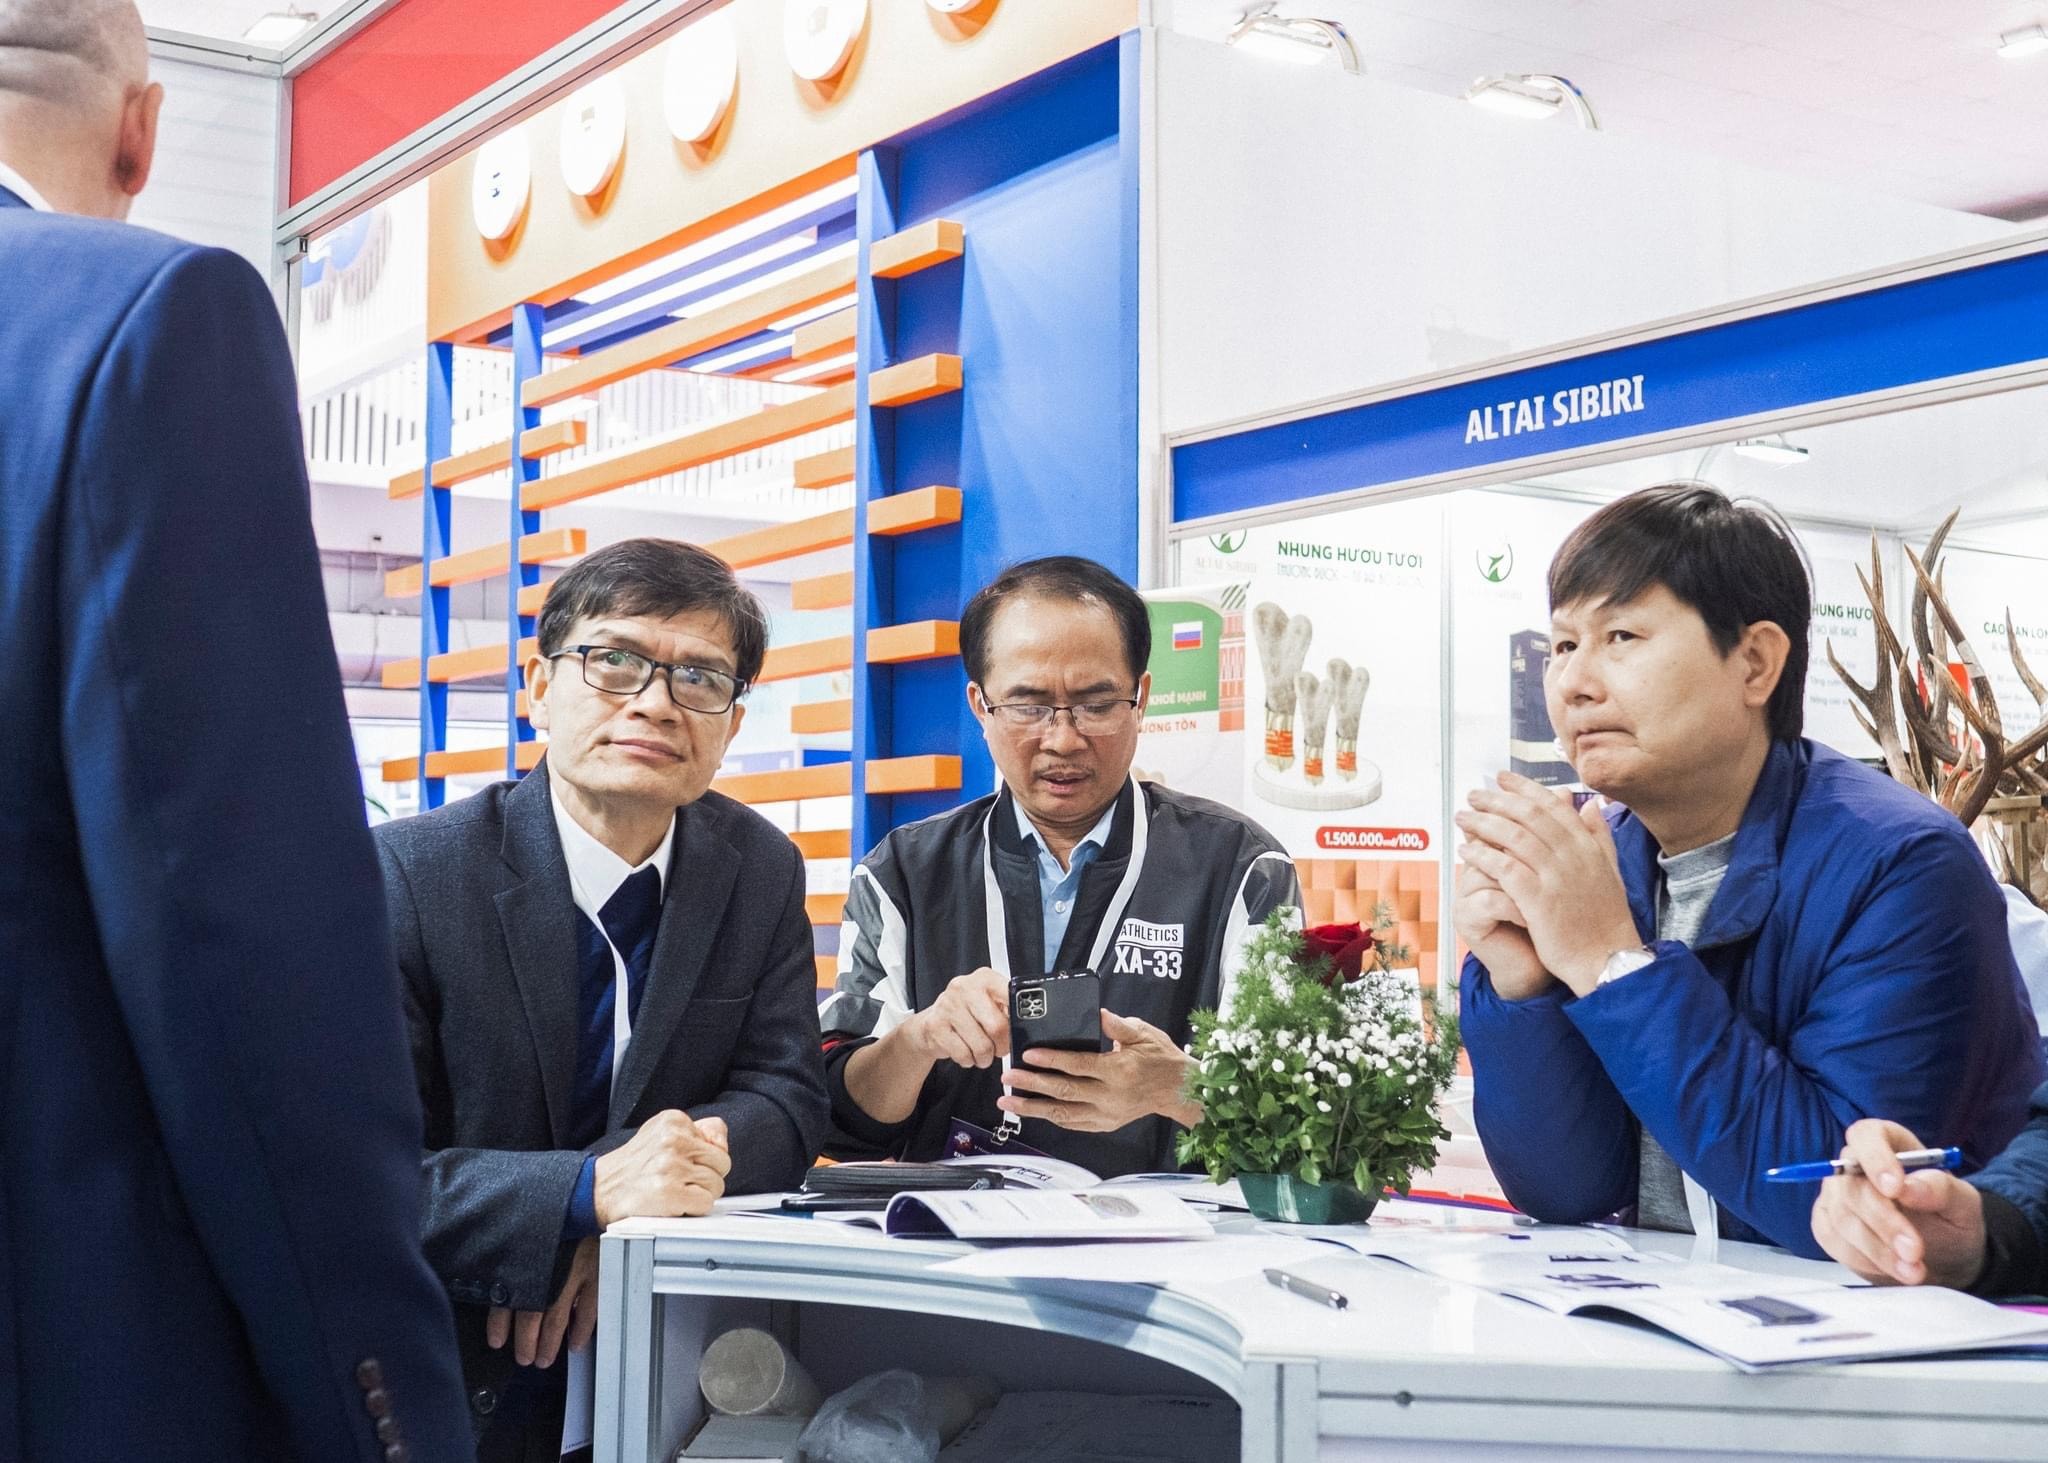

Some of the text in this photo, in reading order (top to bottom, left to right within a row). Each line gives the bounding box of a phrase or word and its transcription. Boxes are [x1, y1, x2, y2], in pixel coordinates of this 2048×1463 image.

[1465, 374, 1645, 444] ALTAI SIBIRI
[1277, 540, 1333, 560] NHUNG
[1810, 602, 1844, 618] HUNG
[1983, 621, 2005, 635] CAO
[2014, 625, 2029, 637] AN
[1120, 923, 1178, 942] ATHLETICS
[1113, 945, 1183, 980] XA-33
